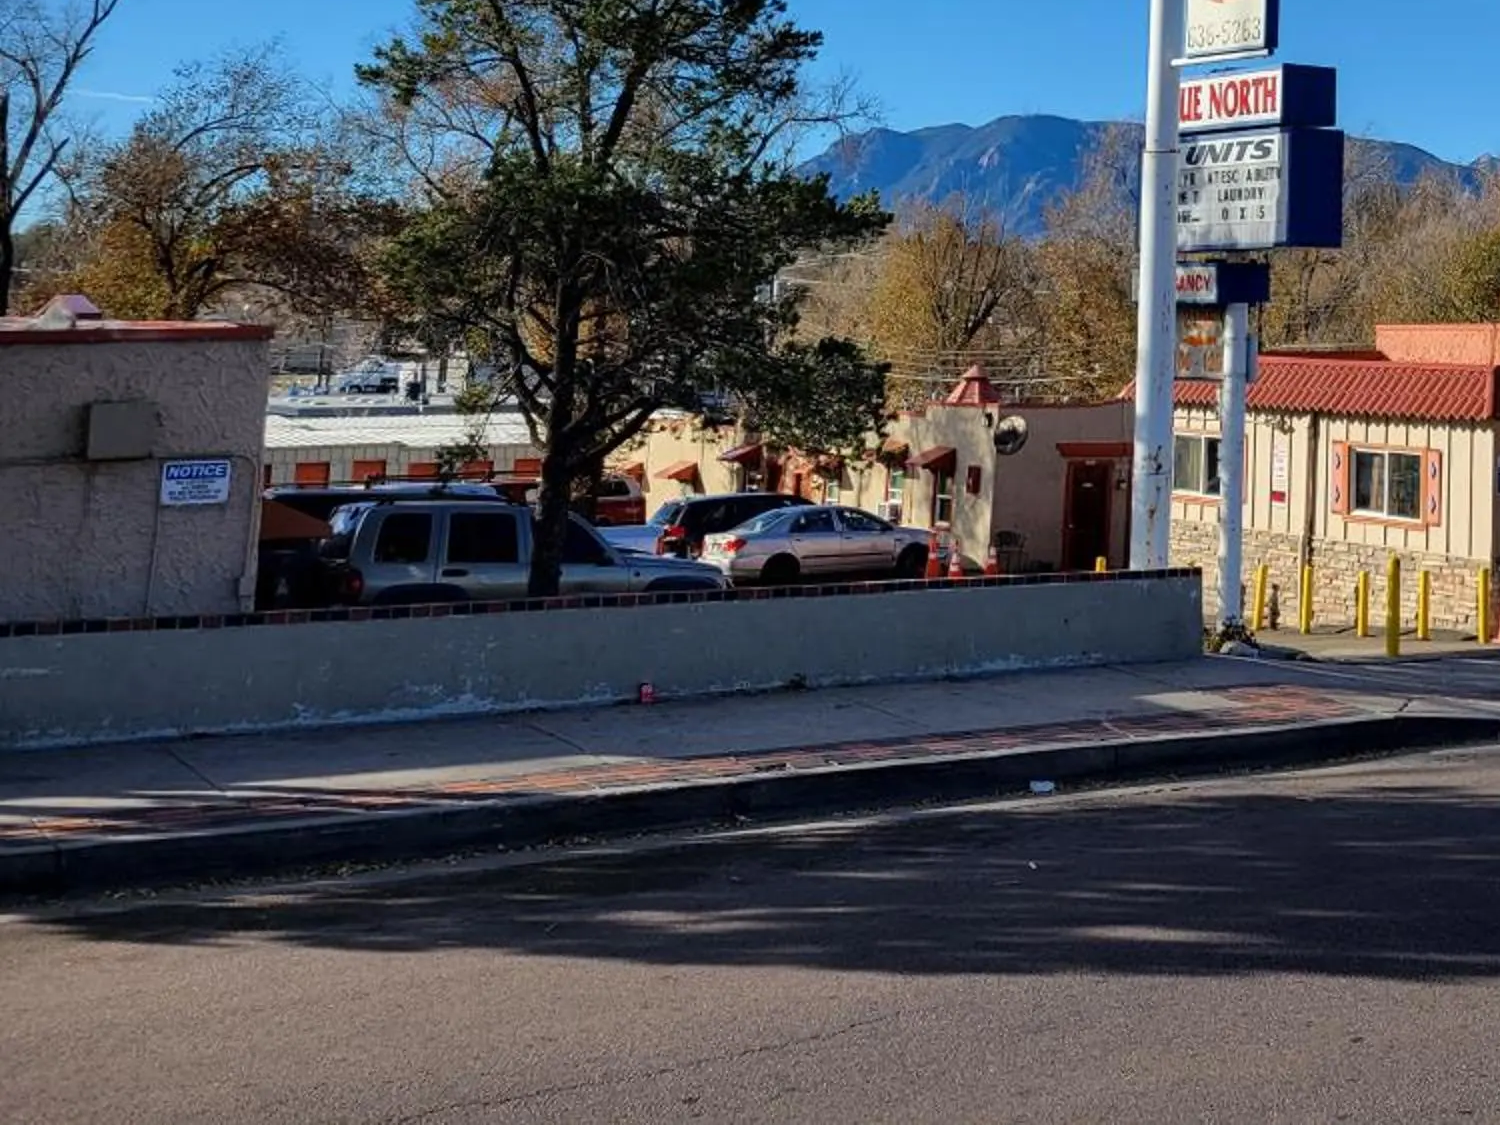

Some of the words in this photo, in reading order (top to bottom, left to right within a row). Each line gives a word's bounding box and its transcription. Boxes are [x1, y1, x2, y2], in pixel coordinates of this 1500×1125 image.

[1208, 76, 1277, 119] NORTH
[1185, 138, 1275, 165] UNITS
[1217, 187, 1265, 203] LAUNDRY
[168, 465, 226, 478] NOTICE
